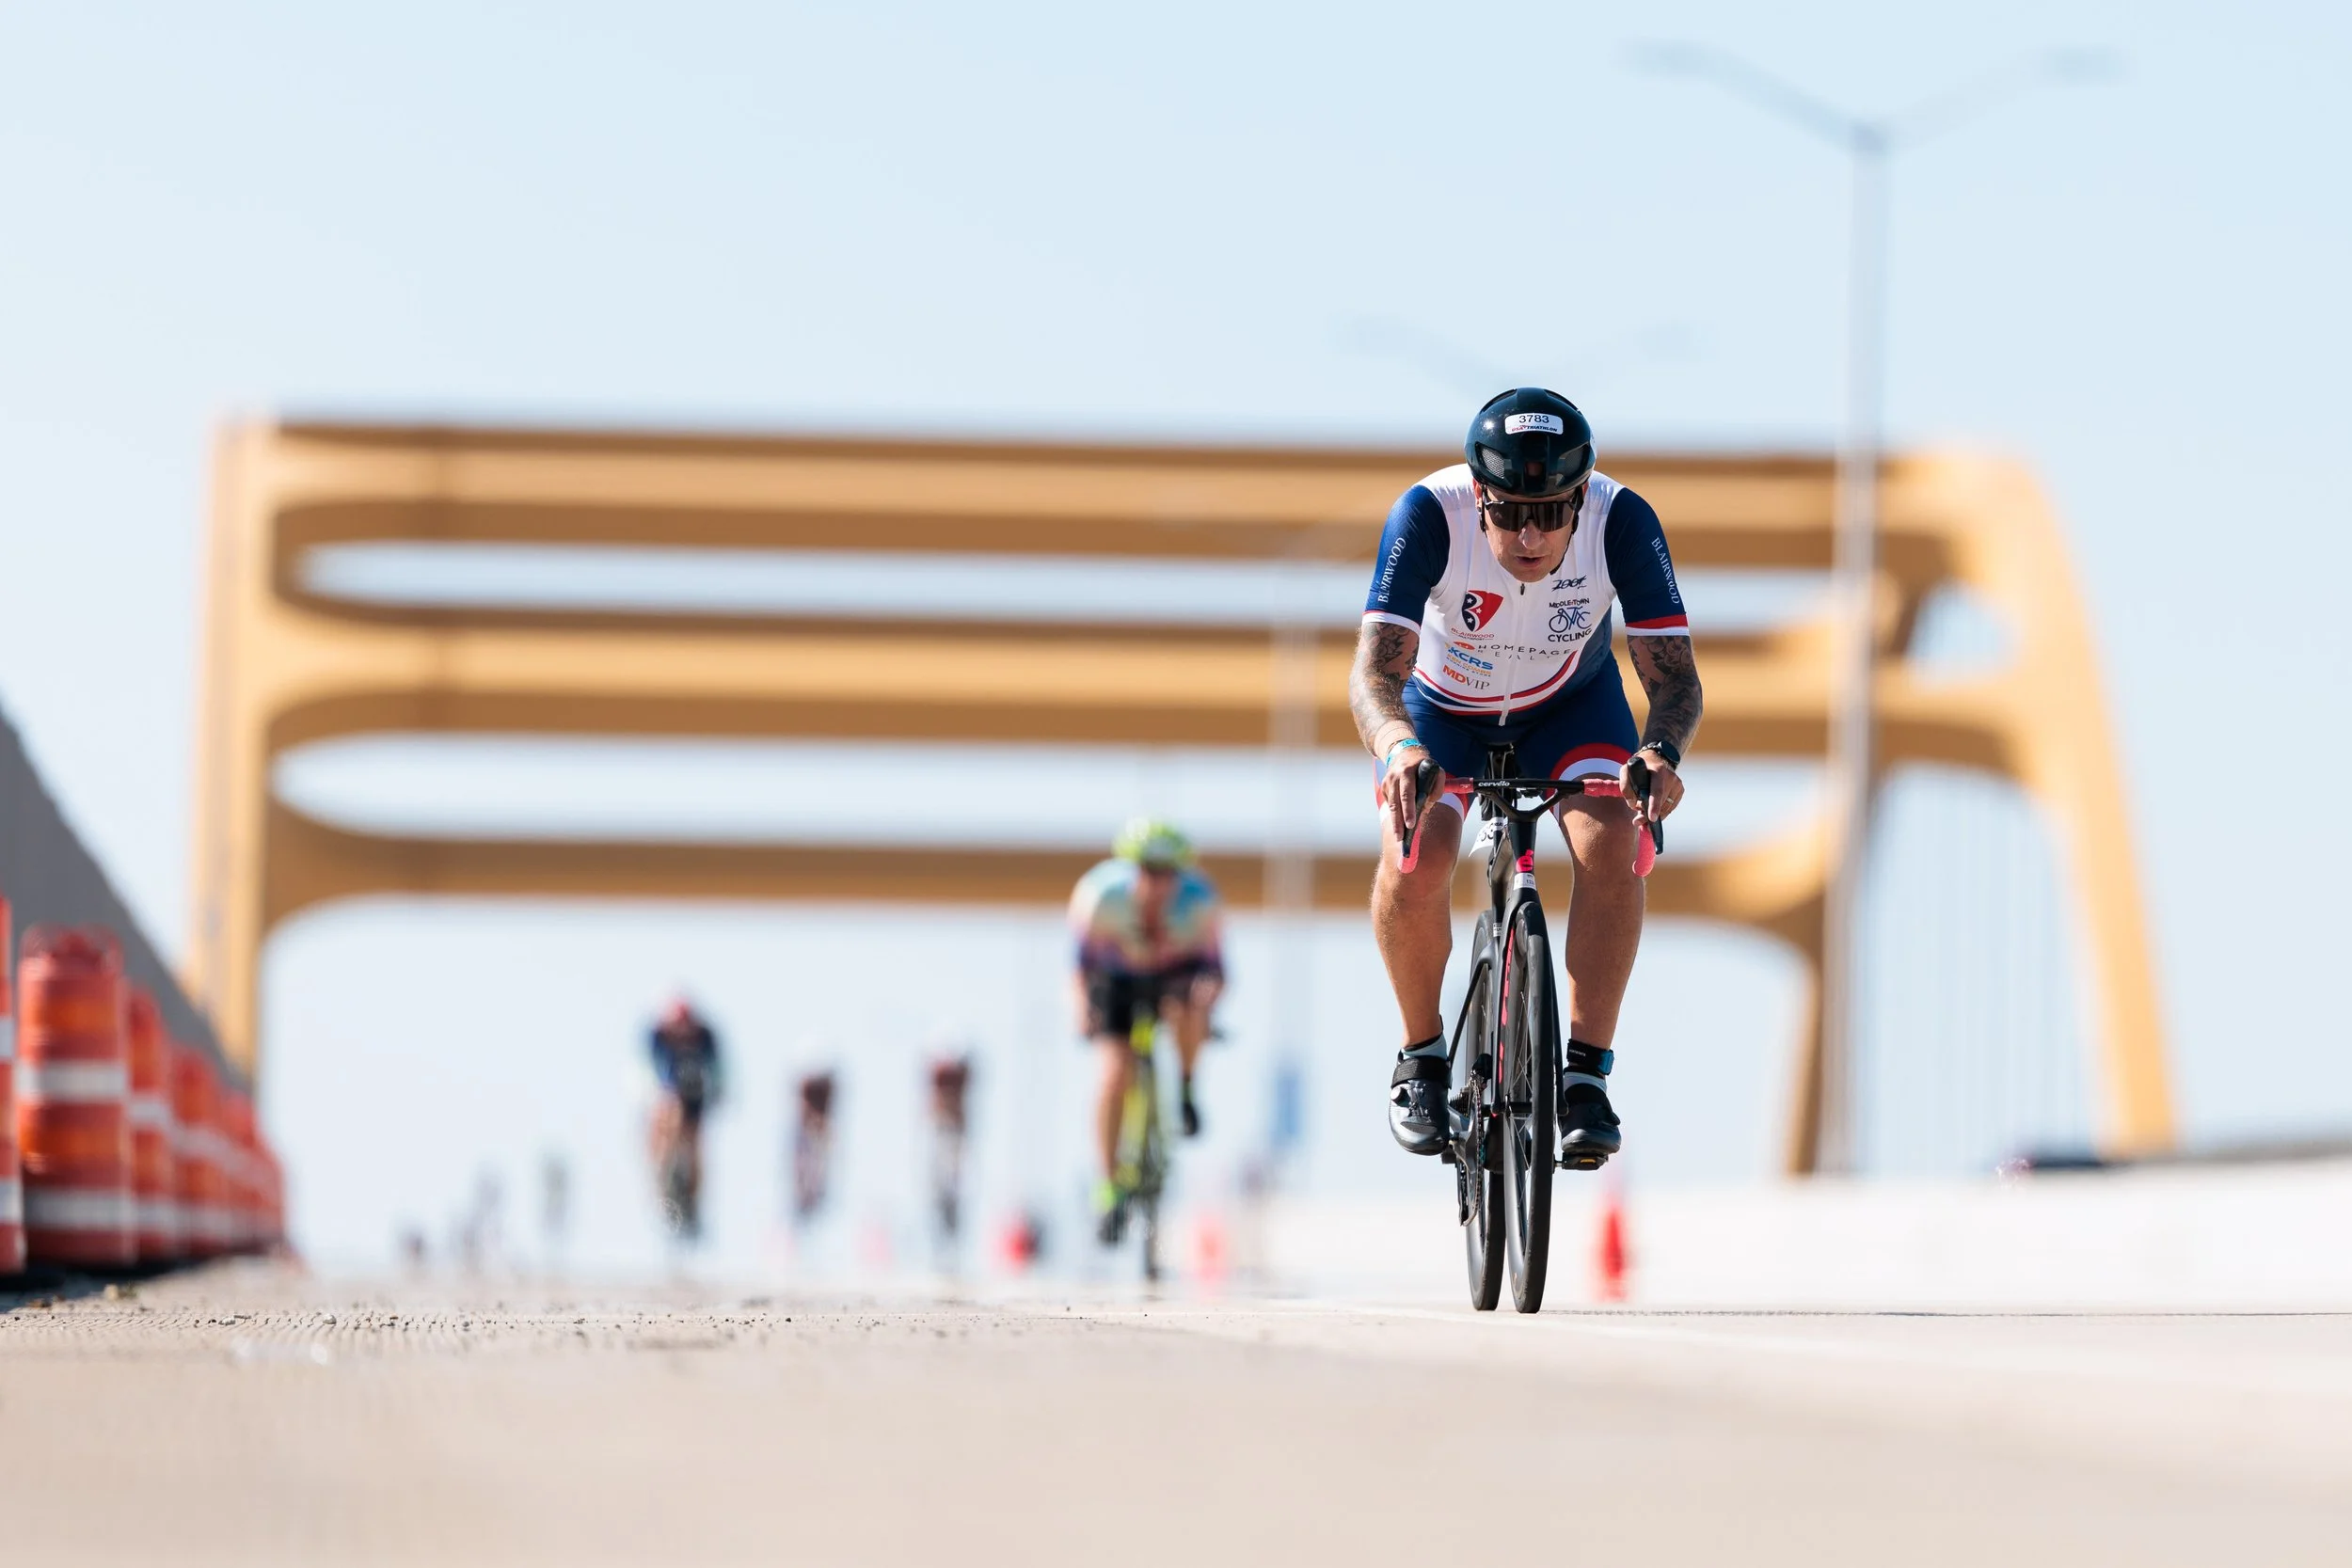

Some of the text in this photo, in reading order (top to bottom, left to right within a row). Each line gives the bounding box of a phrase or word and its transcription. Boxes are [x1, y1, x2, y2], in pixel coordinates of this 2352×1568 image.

[1518, 414, 1549, 423] 3783
[1377, 537, 1406, 604] BLAIRWOOD
[1651, 536, 1680, 604] BLAIRWOOD
[1450, 627, 1495, 639] BLAIRWOOD
[1548, 627, 1593, 642] CYCLING
[1478, 644, 1571, 656] HOMEPAGE
[1448, 647, 1494, 670] KCRS
